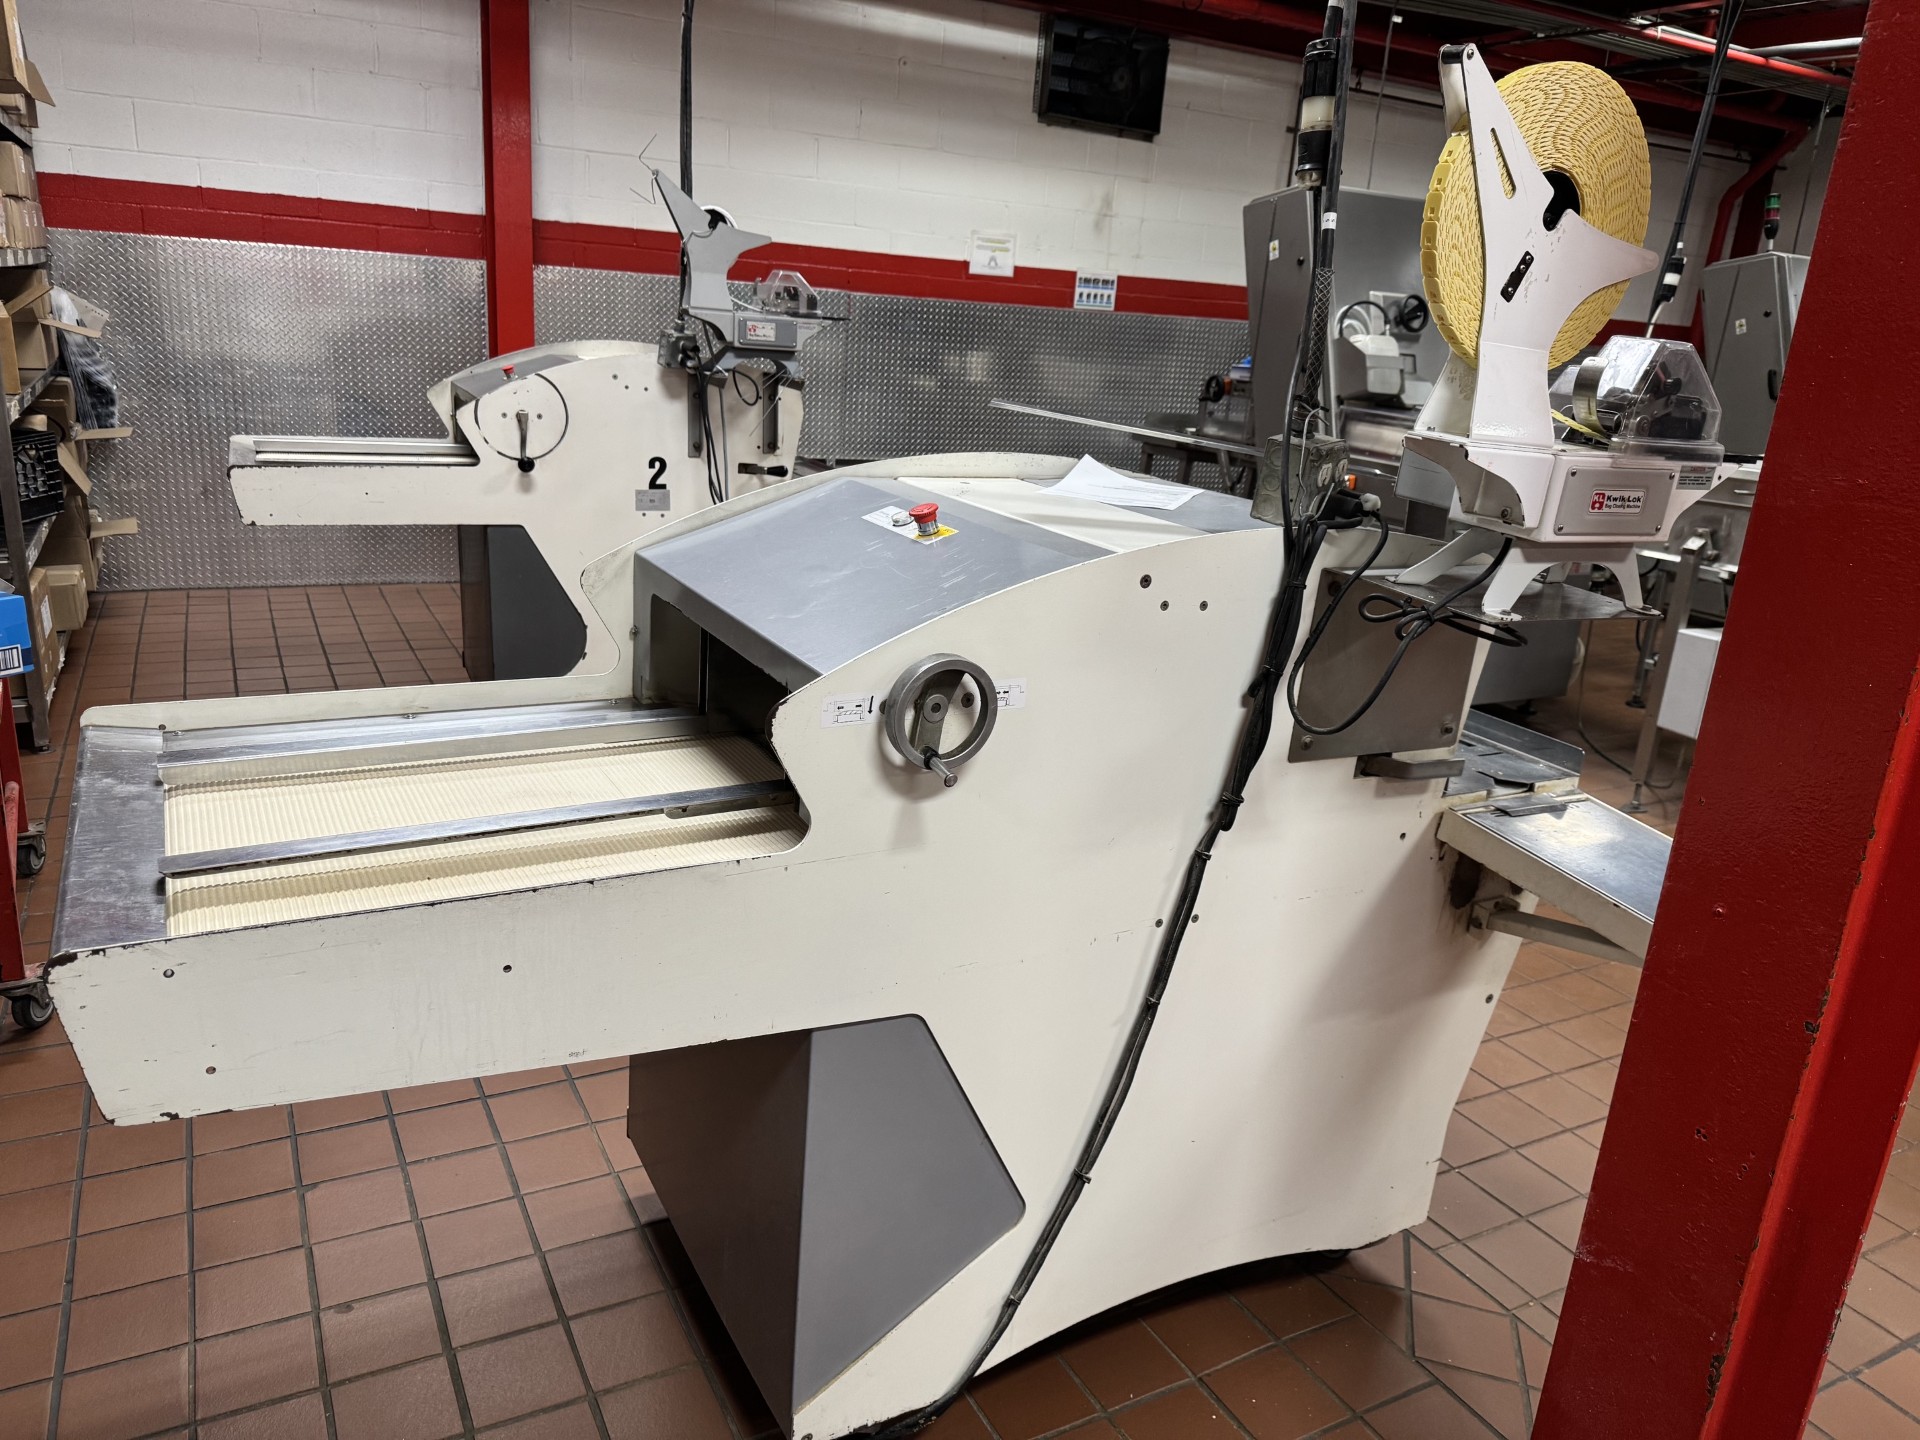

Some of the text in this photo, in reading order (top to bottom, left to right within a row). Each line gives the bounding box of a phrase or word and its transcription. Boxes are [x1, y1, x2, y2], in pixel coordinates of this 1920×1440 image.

[648, 456, 667, 490] 2
[1593, 494, 1604, 502] KL
[1606, 494, 1642, 503] Kwik Lok
